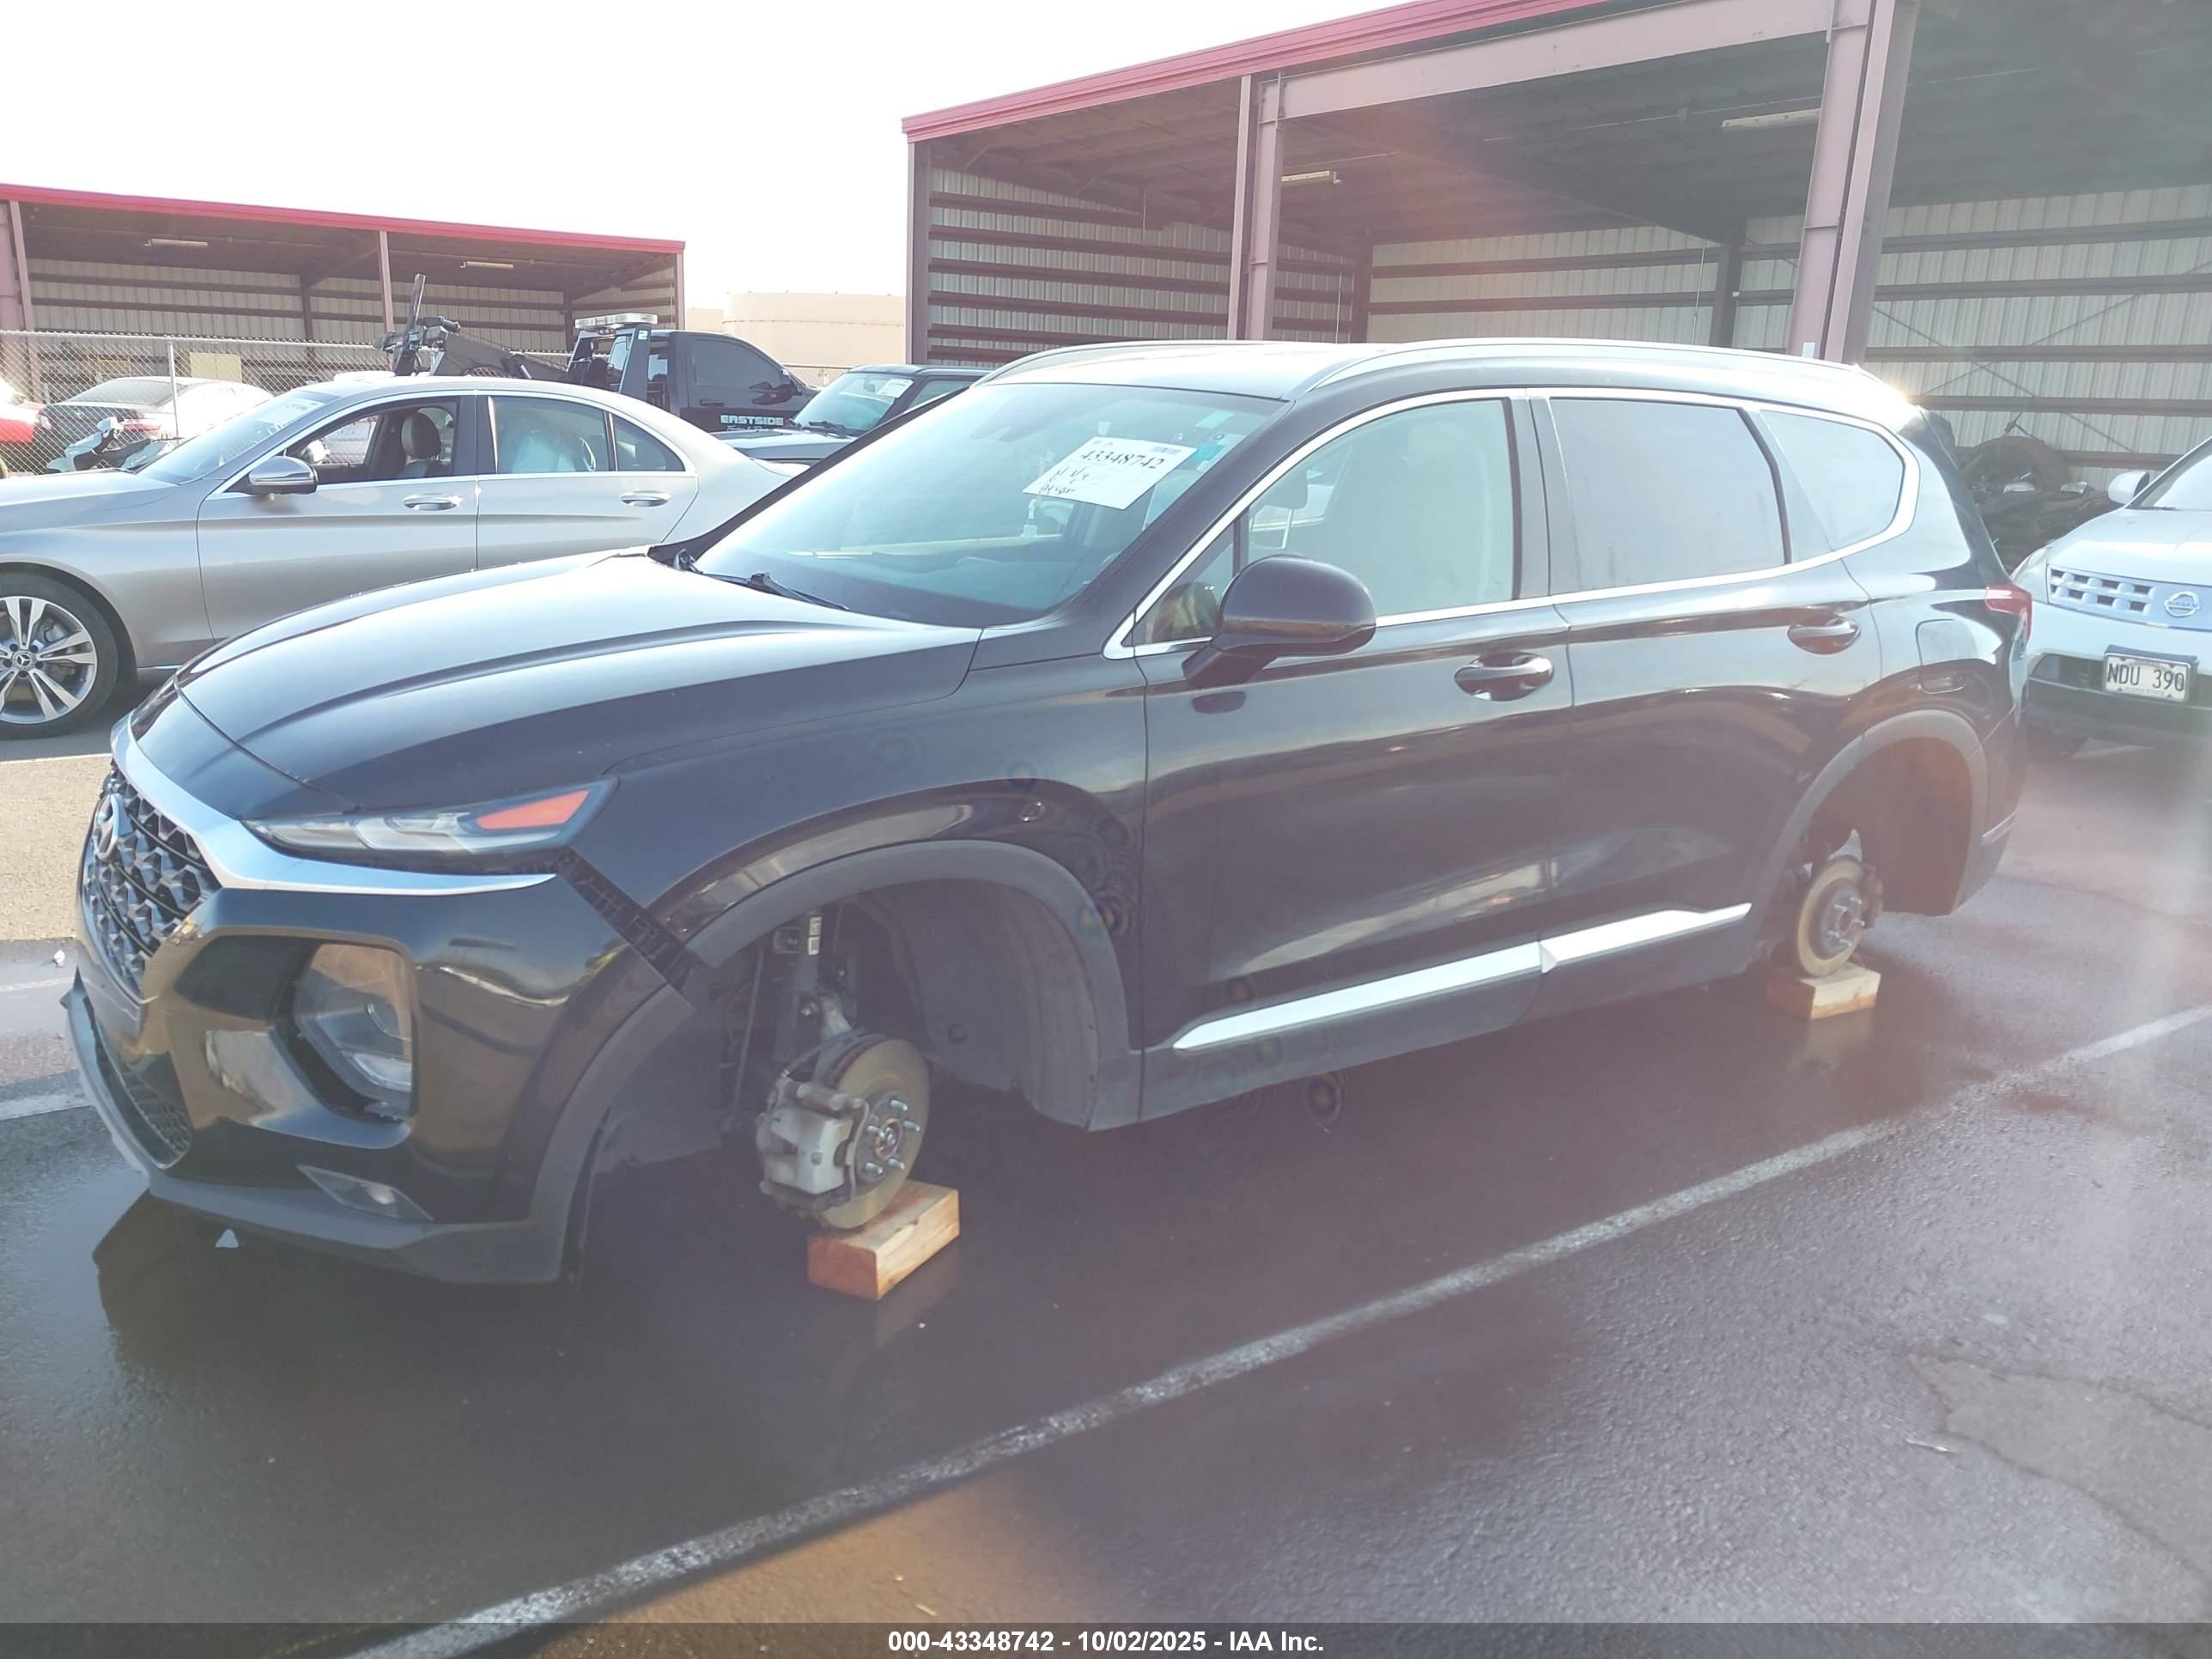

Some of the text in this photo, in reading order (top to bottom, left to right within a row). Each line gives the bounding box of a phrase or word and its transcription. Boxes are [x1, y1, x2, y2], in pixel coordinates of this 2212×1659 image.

[720, 414, 784, 426] EASTSIDE
[1080, 449, 1165, 470] 43348742
[2106, 663, 2141, 686] NDU
[2152, 669, 2185, 692] 390
